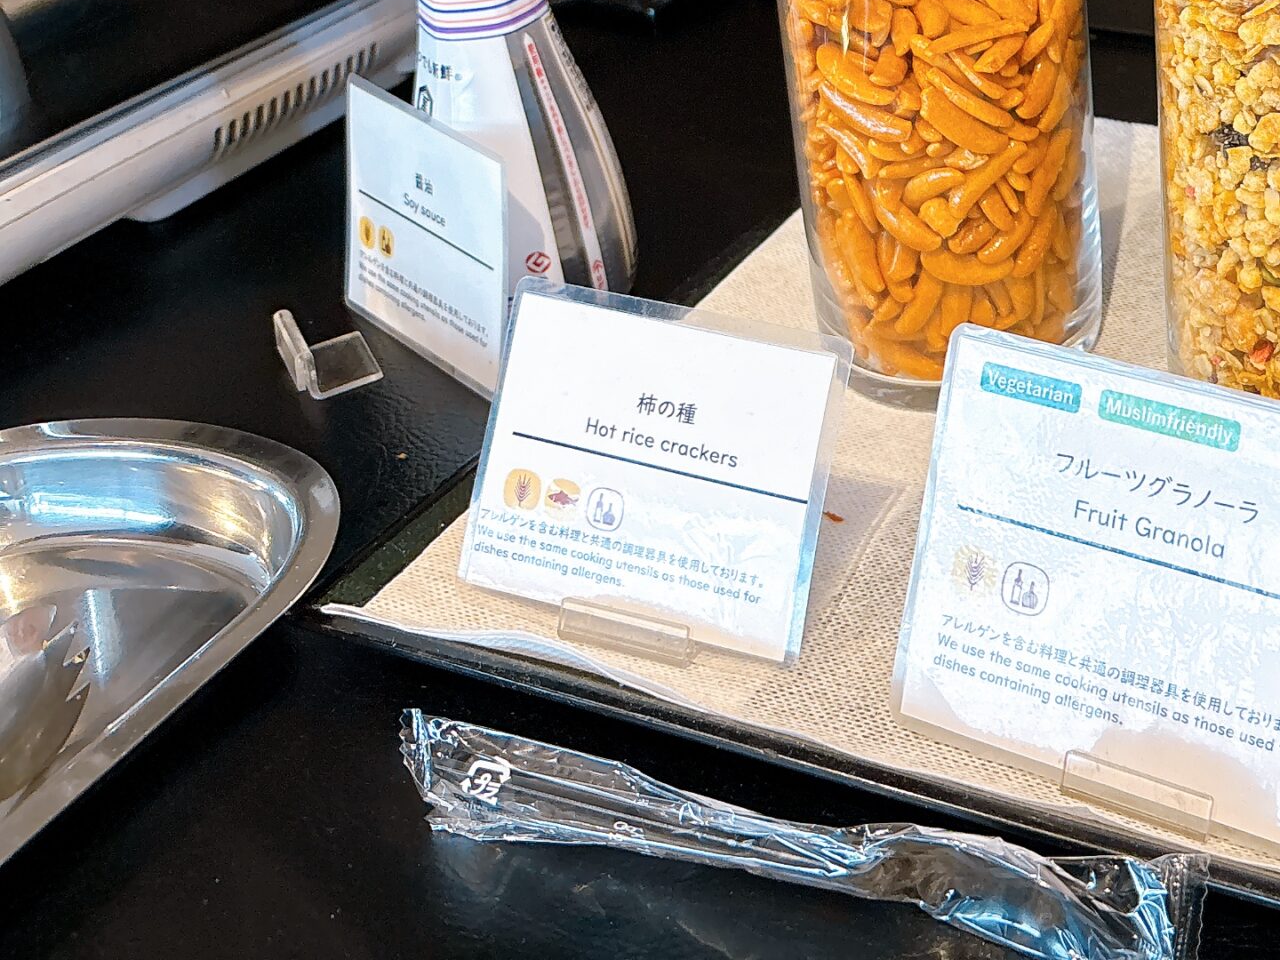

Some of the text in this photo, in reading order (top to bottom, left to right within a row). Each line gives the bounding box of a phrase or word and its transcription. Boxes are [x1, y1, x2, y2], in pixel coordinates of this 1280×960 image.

[403, 192, 446, 228] Soy sauce
[636, 392, 698, 425] 柿の種
[988, 369, 1234, 446] Vegetarian Muslimfriendly
[585, 416, 739, 469] Hot rice crackers
[1055, 452, 1260, 524] フルーツグラノーラ
[1073, 499, 1226, 559] Fruit Granola
[474, 541, 625, 588] dishes containing allergens.
[478, 523, 761, 605] We use the same cooking utensils as those used for
[933, 653, 1125, 727] dishes containing allergens.
[937, 632, 959, 651] We
[961, 643, 987, 659] use
[989, 649, 1013, 668] the
[1015, 659, 1052, 680] same
[1054, 672, 1109, 703] cooking
[1112, 690, 1169, 719] utensils
[1171, 711, 1191, 725] as
[1238, 730, 1276, 752] used
